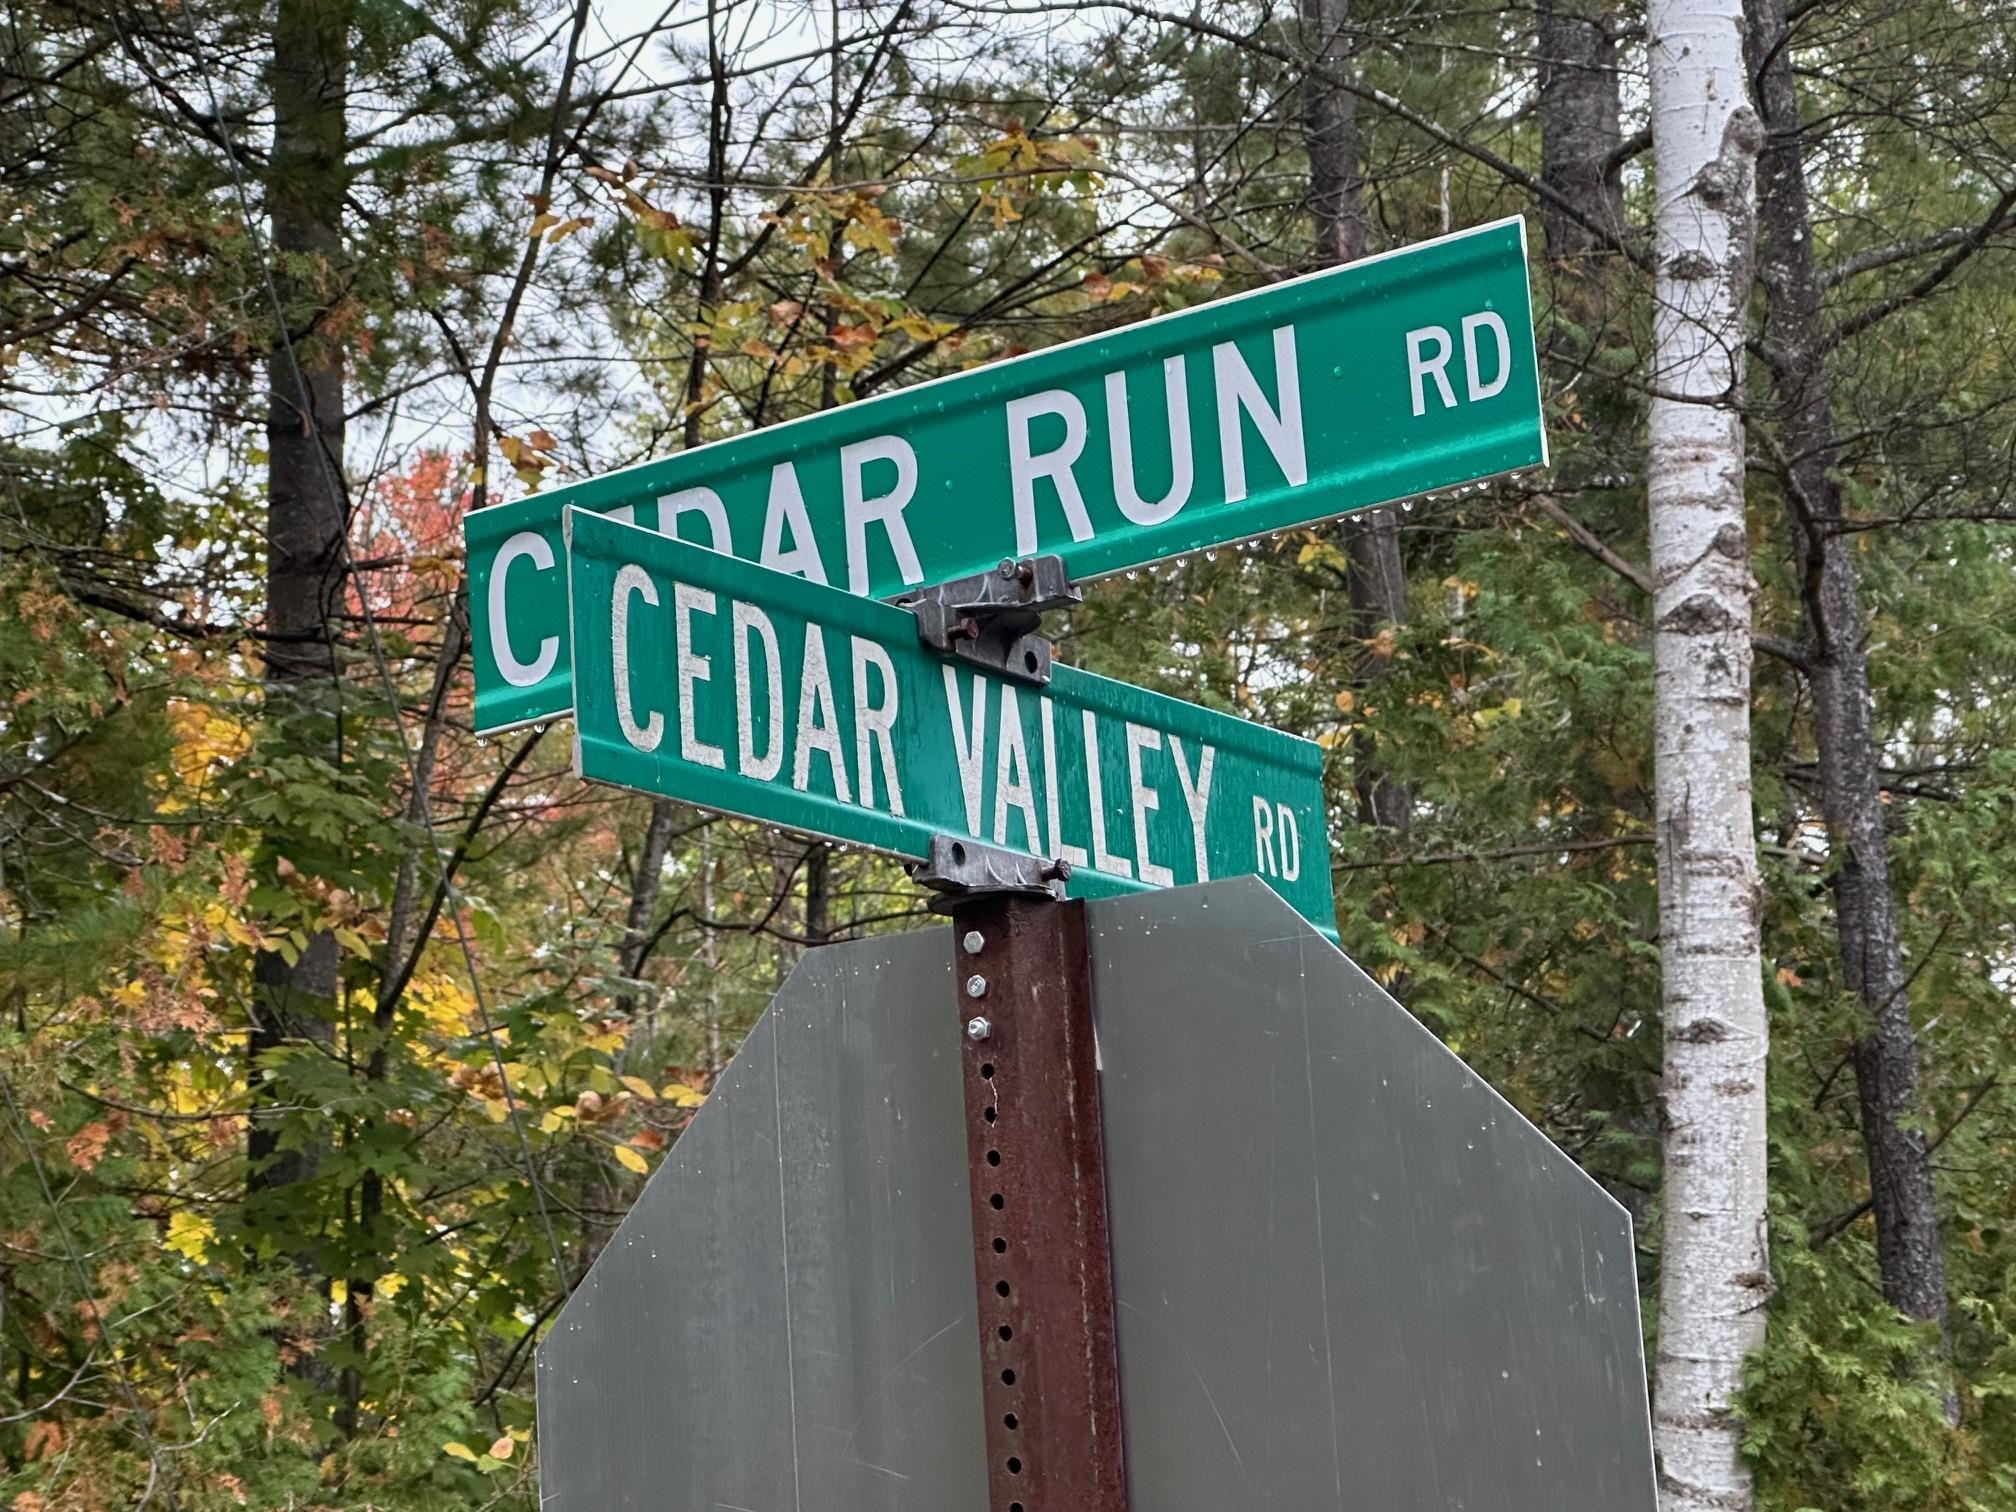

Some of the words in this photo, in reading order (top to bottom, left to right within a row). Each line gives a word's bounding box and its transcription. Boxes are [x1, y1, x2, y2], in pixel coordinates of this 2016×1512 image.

[488, 435, 925, 687] CAR
[1006, 325, 1307, 557] RUN
[1406, 311, 1511, 416] RD
[611, 564, 905, 817] CEDAR
[942, 664, 1215, 888] VALLEY
[1253, 795, 1300, 882] RD
